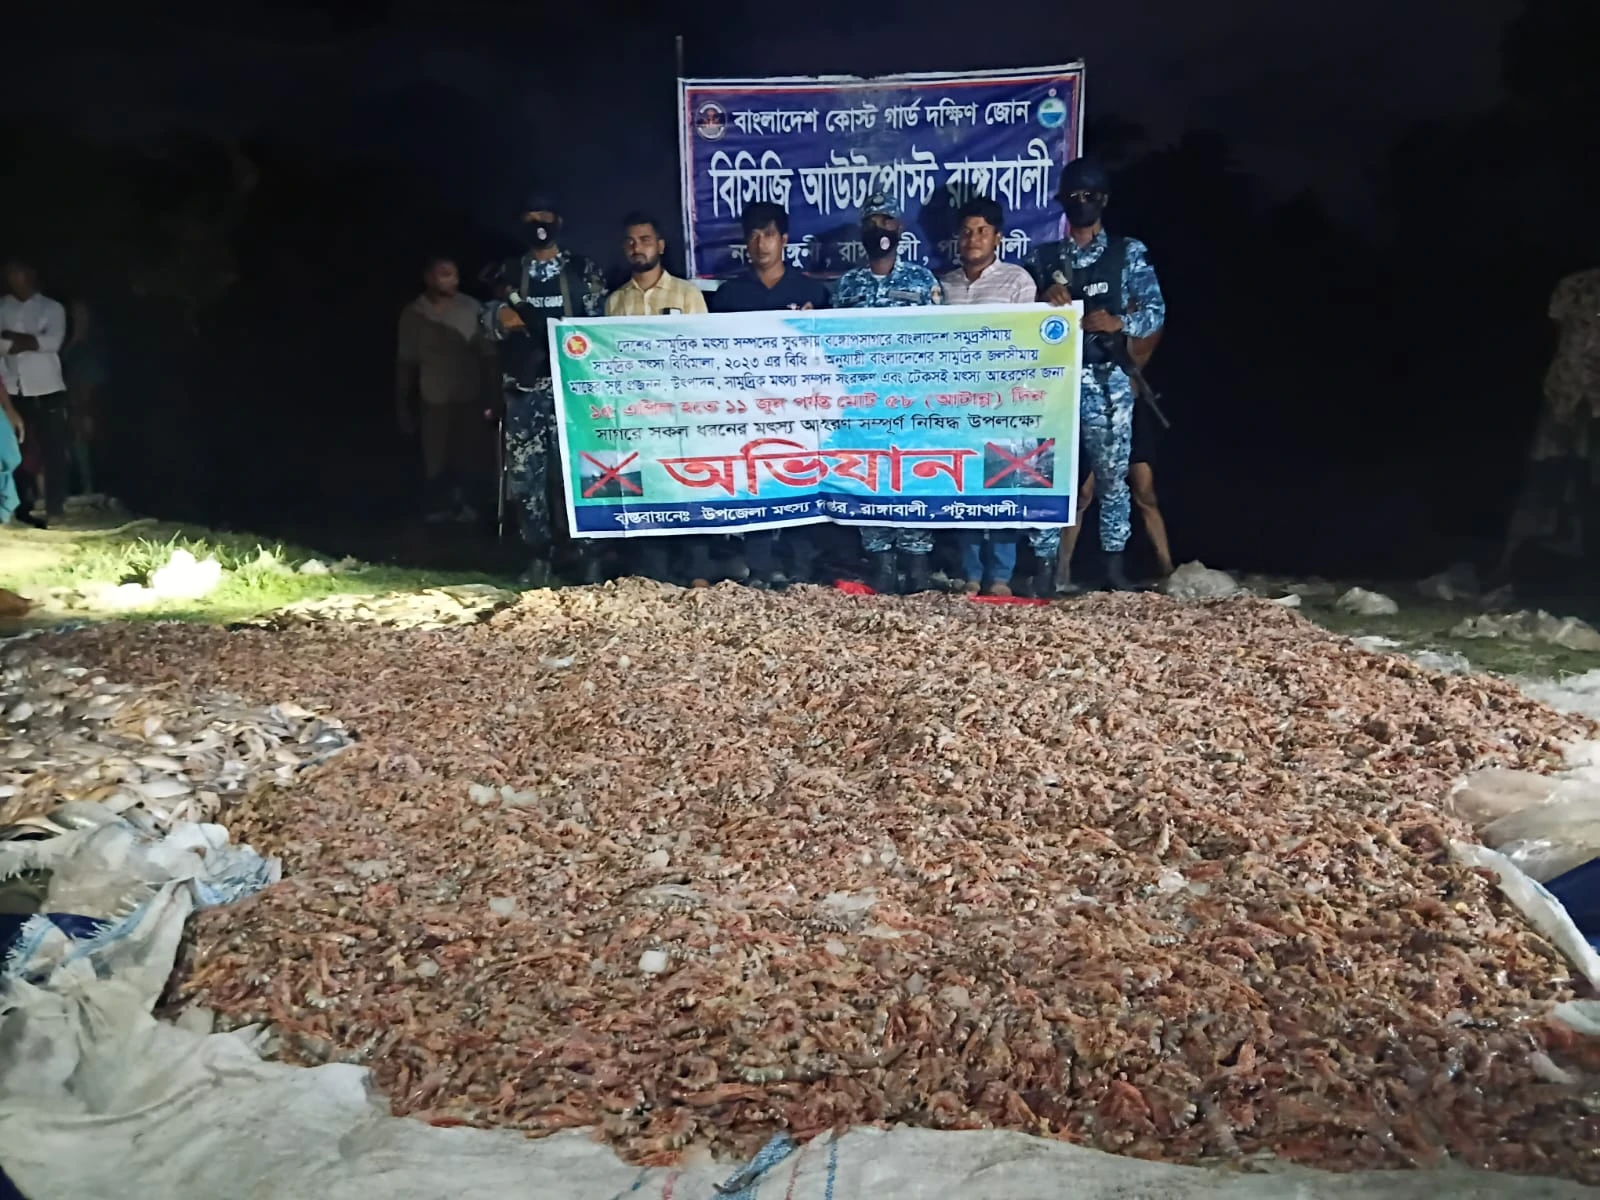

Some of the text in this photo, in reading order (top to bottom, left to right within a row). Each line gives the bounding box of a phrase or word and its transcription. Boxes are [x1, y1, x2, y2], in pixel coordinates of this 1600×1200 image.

[732, 97, 1032, 135] বাংলাদেশ কোস্ট গার্ড দক্ষিণ জোন
[708, 138, 1054, 218] বিসিজি আউটপোস্ট রাঙ্গাবালী
[616, 339, 652, 353] দেশের
[656, 334, 697, 353] সামুদ্রিক
[701, 338, 730, 350] মৎস্য
[733, 336, 778, 349] সম্পদের
[824, 333, 893, 348] বঙ্গোপসাগরে
[897, 332, 950, 345] বাংলাদেশ
[953, 326, 1013, 345] সমুদ্রসীমায়
[592, 355, 634, 376] সামুদ্রিক
[637, 359, 665, 371] মৎস্য
[725, 357, 760, 370] ২০২৩
[764, 355, 781, 368] এর
[784, 352, 808, 367] বিধি
[824, 350, 866, 369] অনুযায়ী
[870, 351, 936, 366] বাংলাদেশের
[939, 346, 983, 366] সামুদ্রিক
[986, 345, 1040, 362] জলসীমায়
[724, 371, 766, 391] সামুদ্রিক
[769, 374, 799, 387] মৎস্য
[801, 373, 833, 385] সম্পদ
[836, 373, 877, 384] সংরক্ষণ
[881, 371, 904, 384] এবং
[907, 368, 949, 384] টেকসই
[953, 370, 982, 384] মৎস্য
[986, 368, 1037, 383] আহরণের
[680, 400, 721, 414] হতে
[725, 399, 749, 414] ১১
[755, 397, 788, 415] জুন
[837, 391, 878, 409] মোট
[884, 394, 916, 409] ৫৮
[1011, 385, 1048, 404] দিন
[594, 427, 643, 442] সাগরে
[648, 425, 690, 438] সকল
[697, 423, 749, 436] ধরনের
[753, 420, 795, 434] মৎস্য
[859, 413, 906, 435] সম্পূর্ণ
[911, 413, 961, 431] নিষিদ্ধ
[655, 437, 979, 497] অভিযান
[701, 504, 767, 522] উপজেলা
[773, 500, 811, 517] মৎস্য
